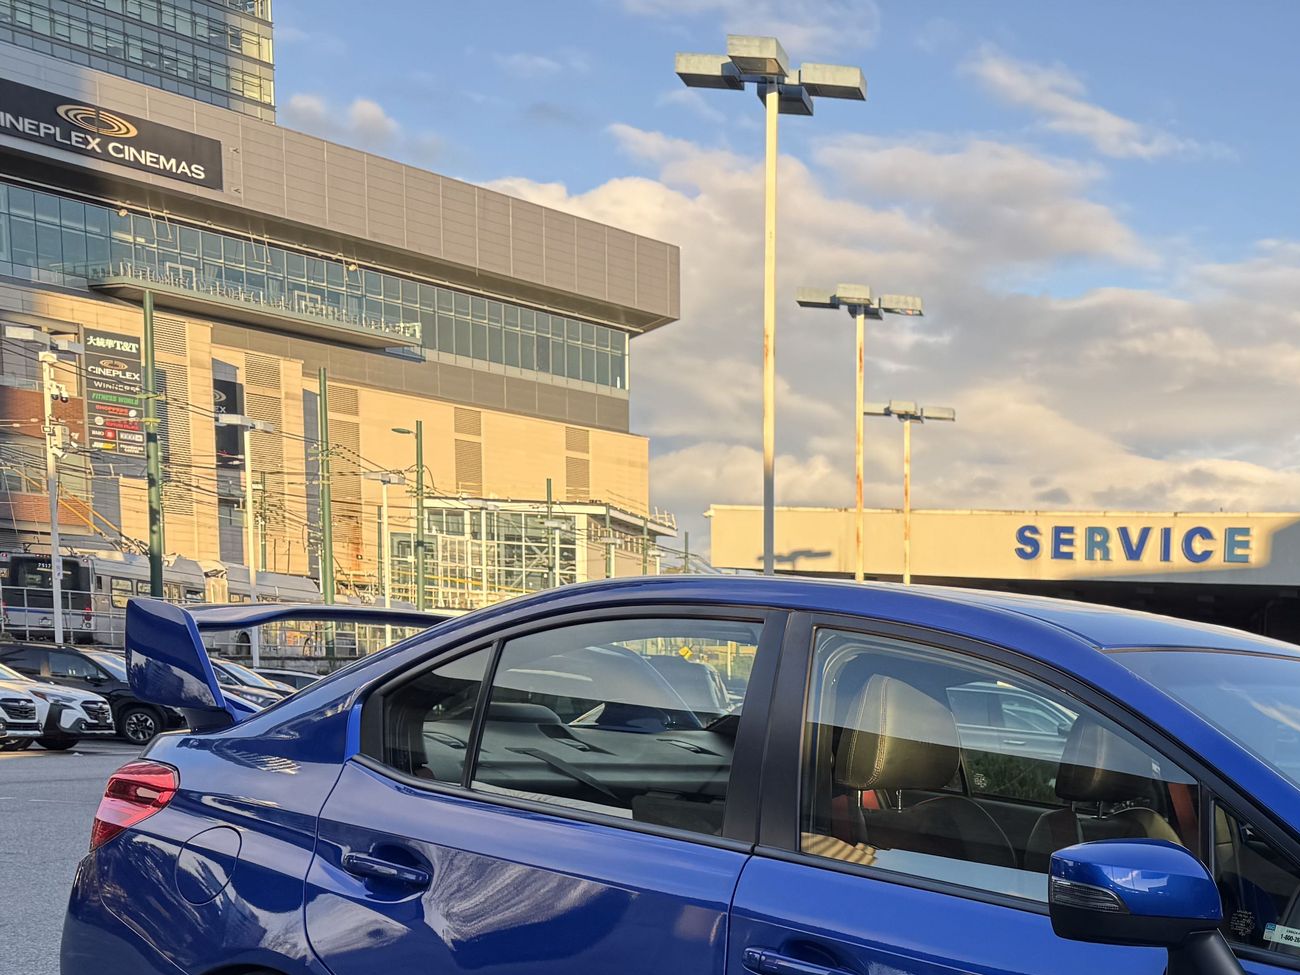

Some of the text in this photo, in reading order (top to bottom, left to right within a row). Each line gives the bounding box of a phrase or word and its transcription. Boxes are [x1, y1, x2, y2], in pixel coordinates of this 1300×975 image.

[0, 111, 205, 179] INEPLEX CINEMAS
[87, 365, 140, 381] CINEPLEX
[1014, 525, 1252, 563] SERVICE
